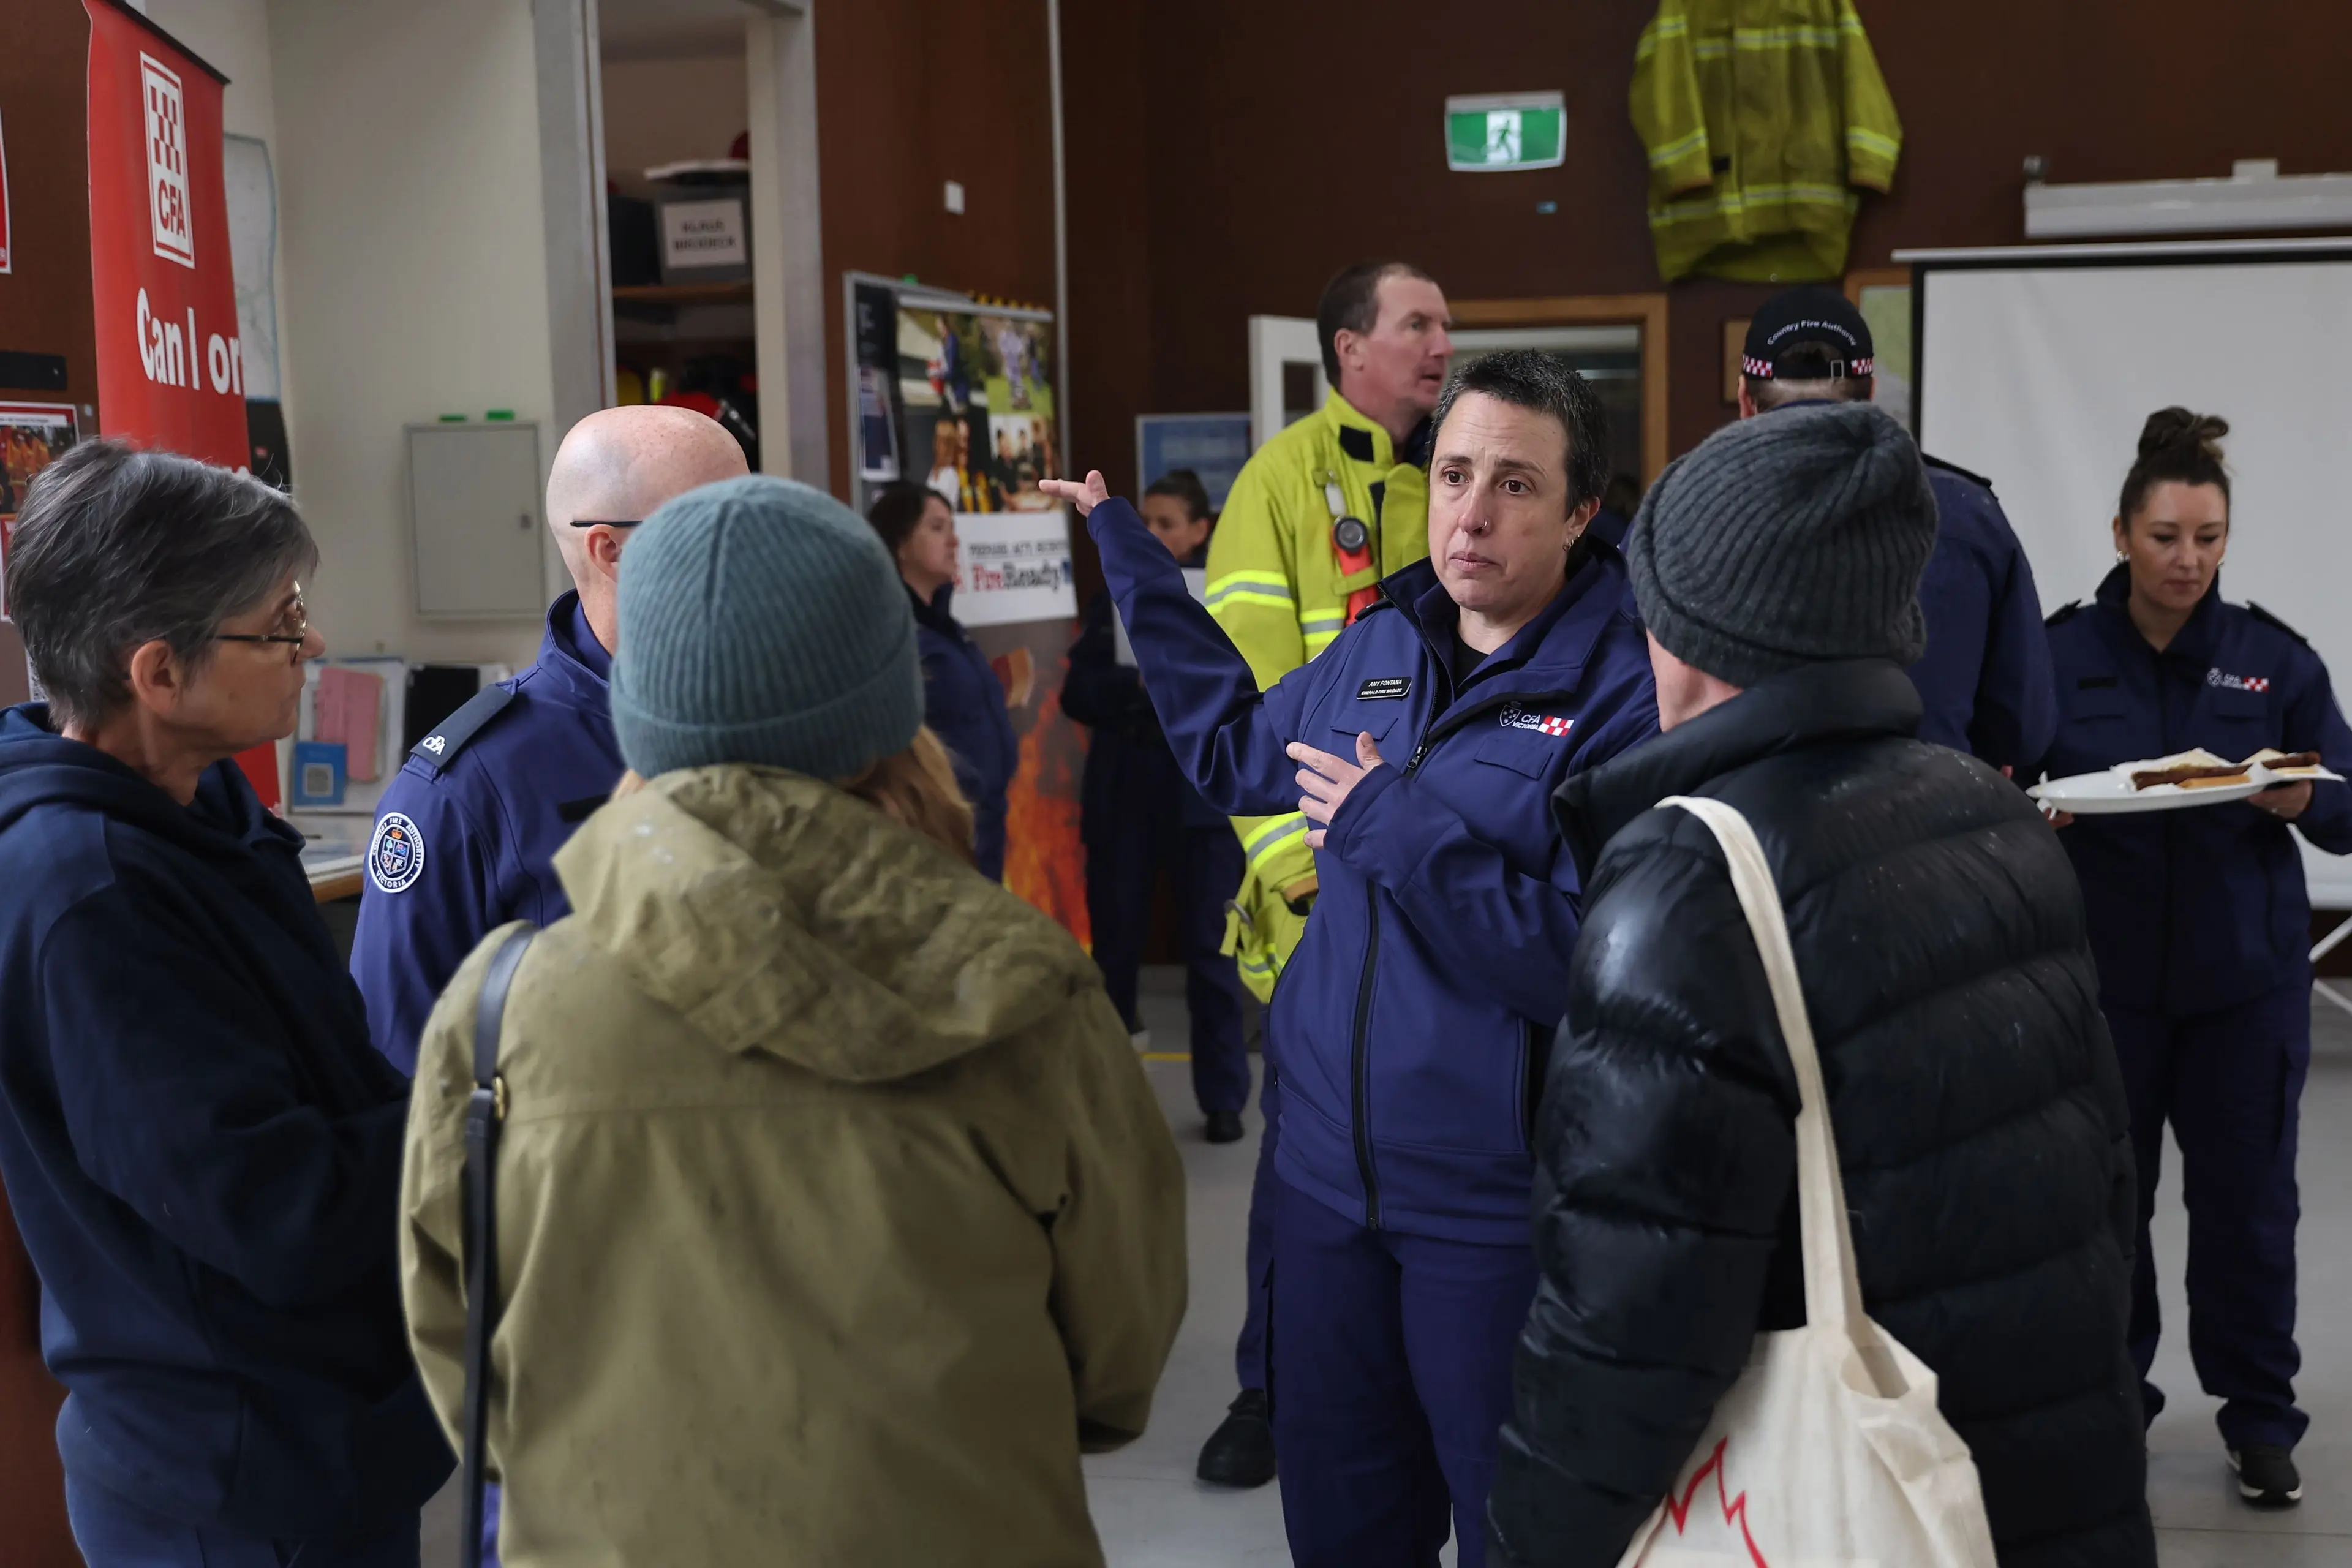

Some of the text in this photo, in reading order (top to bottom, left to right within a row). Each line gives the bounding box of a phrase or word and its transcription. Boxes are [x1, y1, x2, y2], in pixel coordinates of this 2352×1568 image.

[157, 178, 186, 240] CFA
[136, 286, 186, 388] Can
[186, 306, 201, 391] I
[1767, 322, 1799, 345] Country
[1801, 319, 1820, 328] Fire
[1512, 721, 1539, 731] VICTORIA
[1521, 714, 1541, 724] CFA
[405, 823, 422, 869] AUTHORITY
[375, 870, 407, 888] VICTORIA
